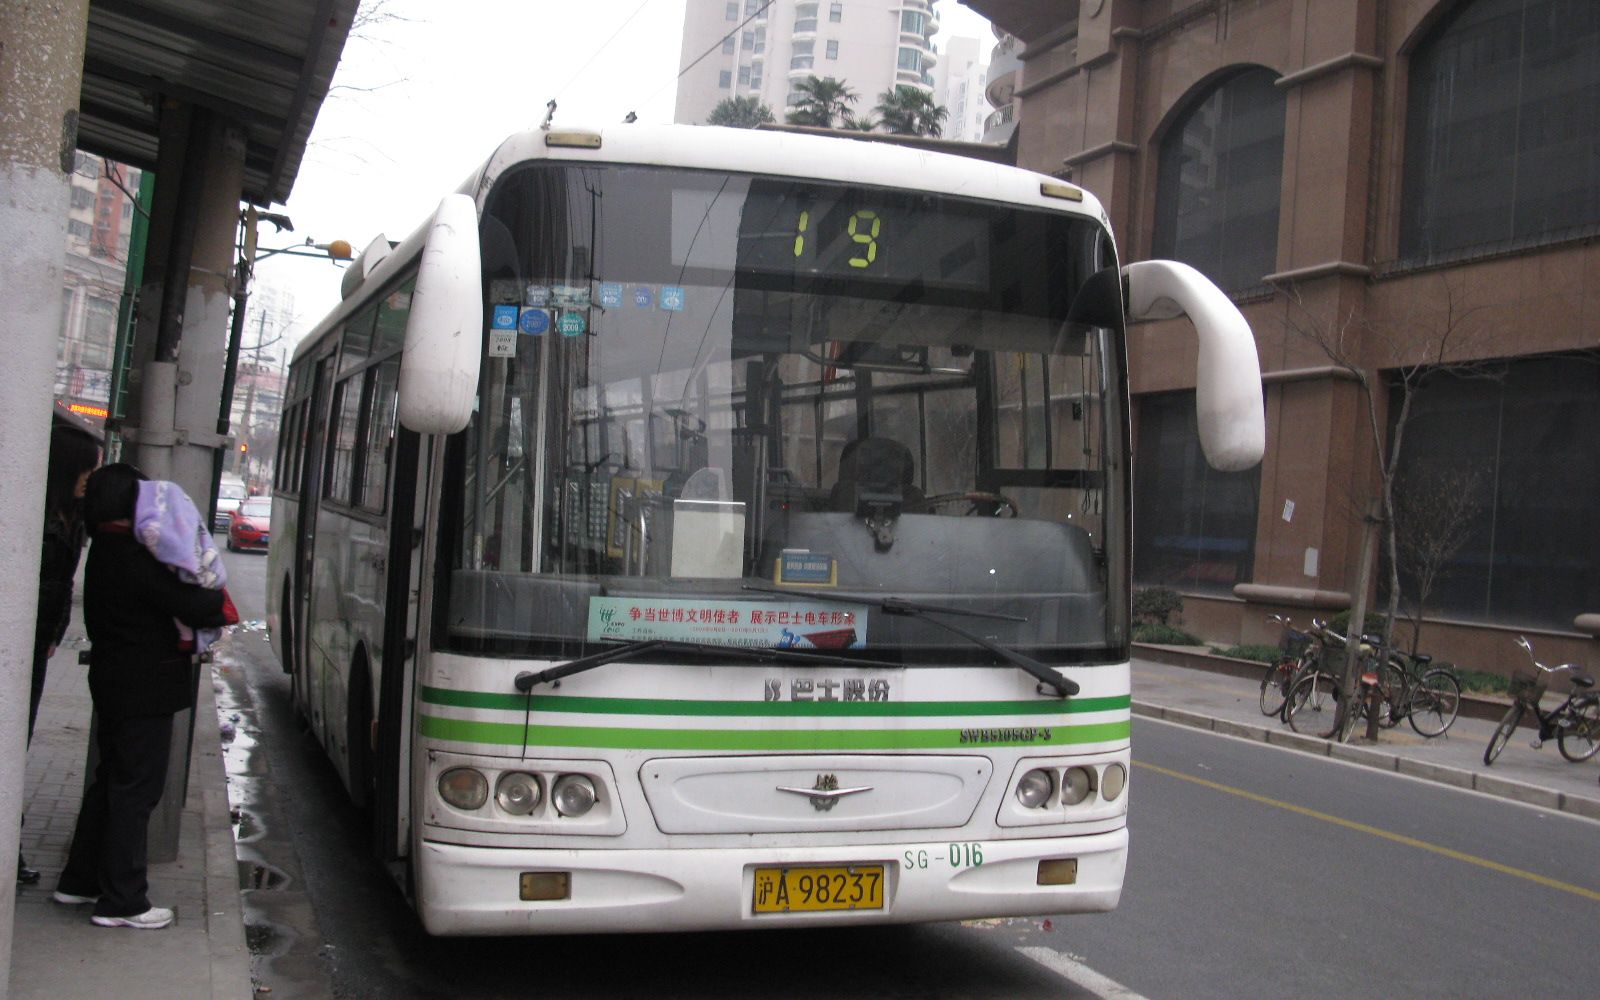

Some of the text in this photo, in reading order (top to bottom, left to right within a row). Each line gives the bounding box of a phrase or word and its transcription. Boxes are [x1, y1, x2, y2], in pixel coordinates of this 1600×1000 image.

[794, 210, 880, 268] 19
[629, 606, 856, 625] 争当世博文明使者 展示巴士电车形象
[791, 678, 890, 702] 巴士股份
